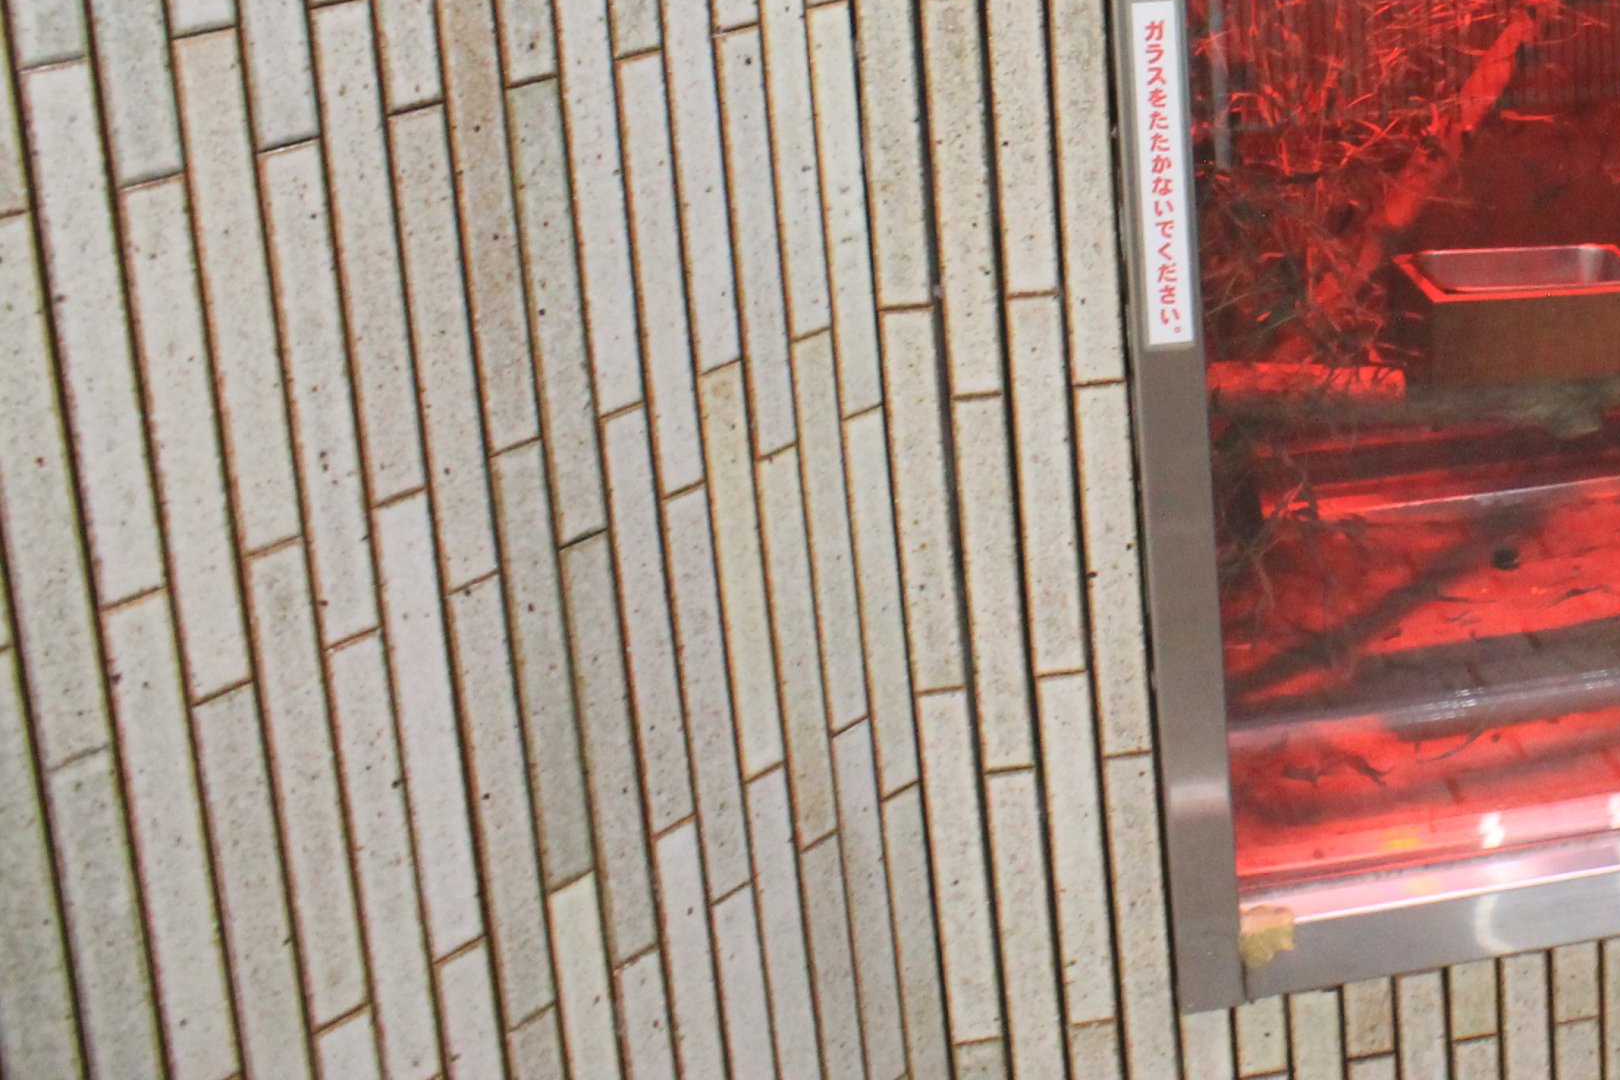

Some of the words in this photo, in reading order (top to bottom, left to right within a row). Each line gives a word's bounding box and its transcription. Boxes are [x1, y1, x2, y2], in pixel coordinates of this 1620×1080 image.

[1145, 20, 1181, 334] ガラスをたたかないでください。
